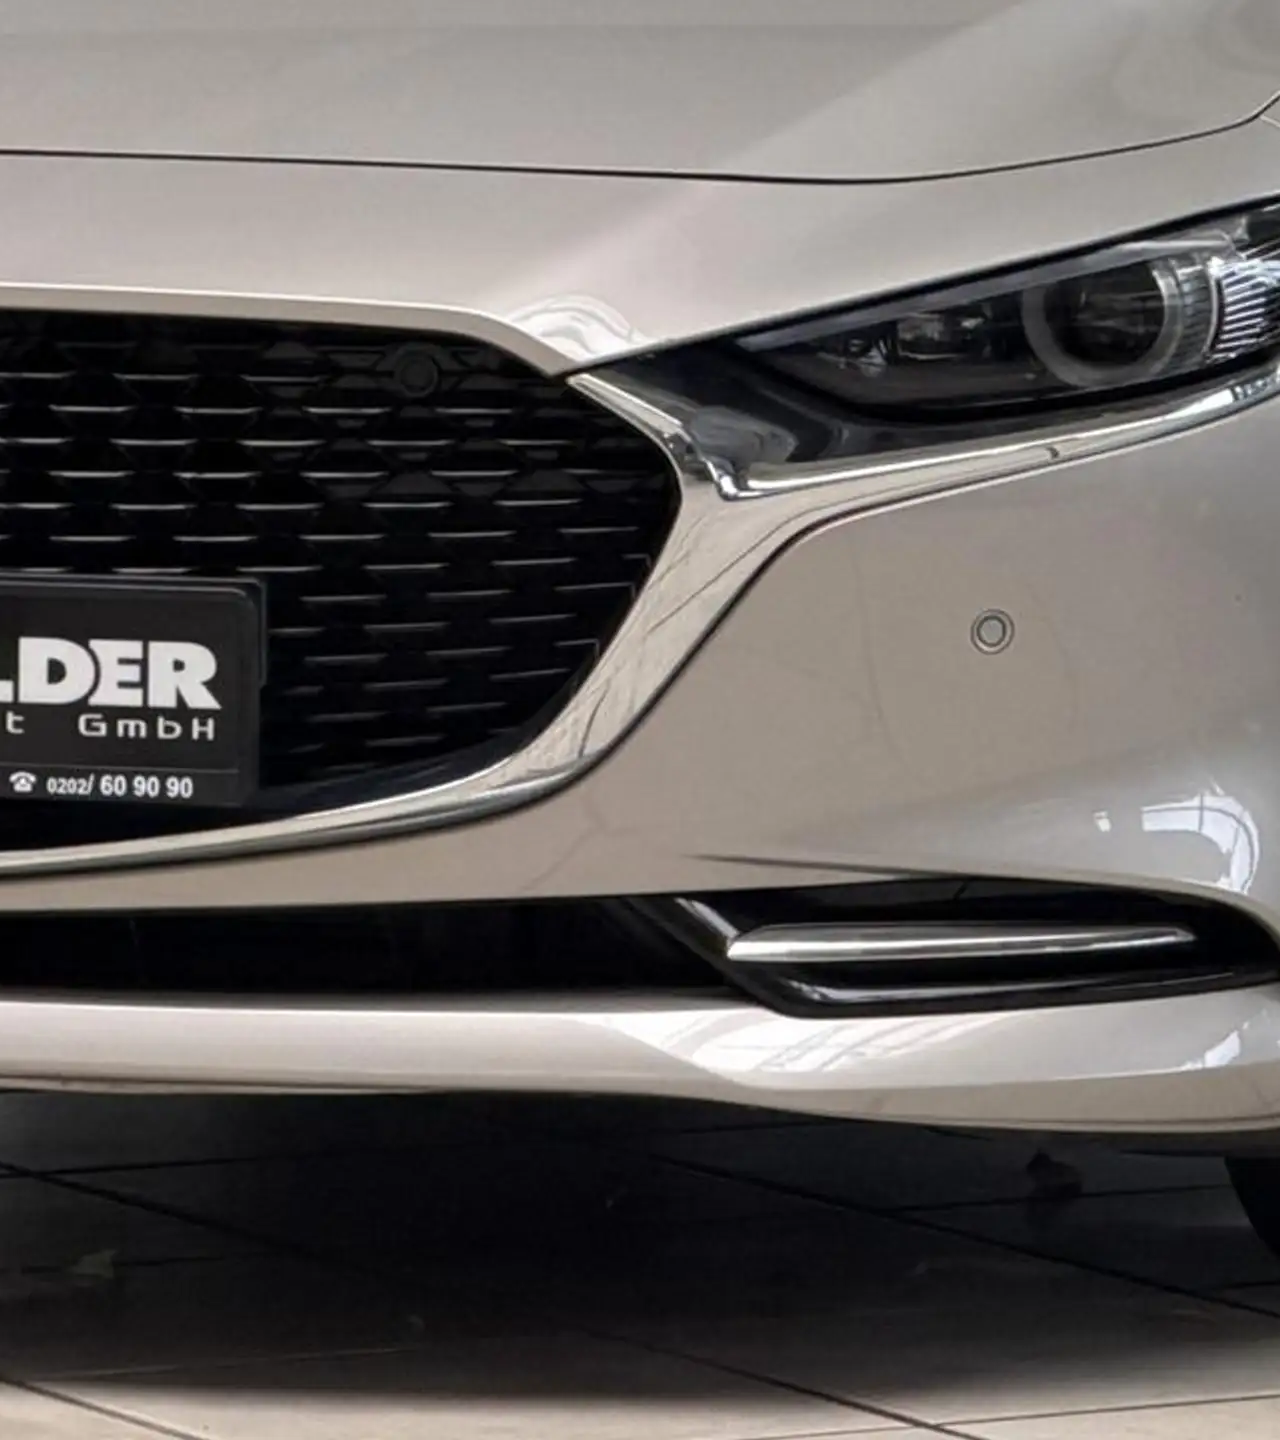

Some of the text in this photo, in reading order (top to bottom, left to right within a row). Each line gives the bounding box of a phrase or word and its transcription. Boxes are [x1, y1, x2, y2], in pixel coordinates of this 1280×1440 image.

[77, 713, 215, 741] GmbH
[46, 772, 95, 796] 0202/
[99, 773, 128, 797] 60
[131, 774, 161, 799] 90
[165, 775, 194, 799] 90
